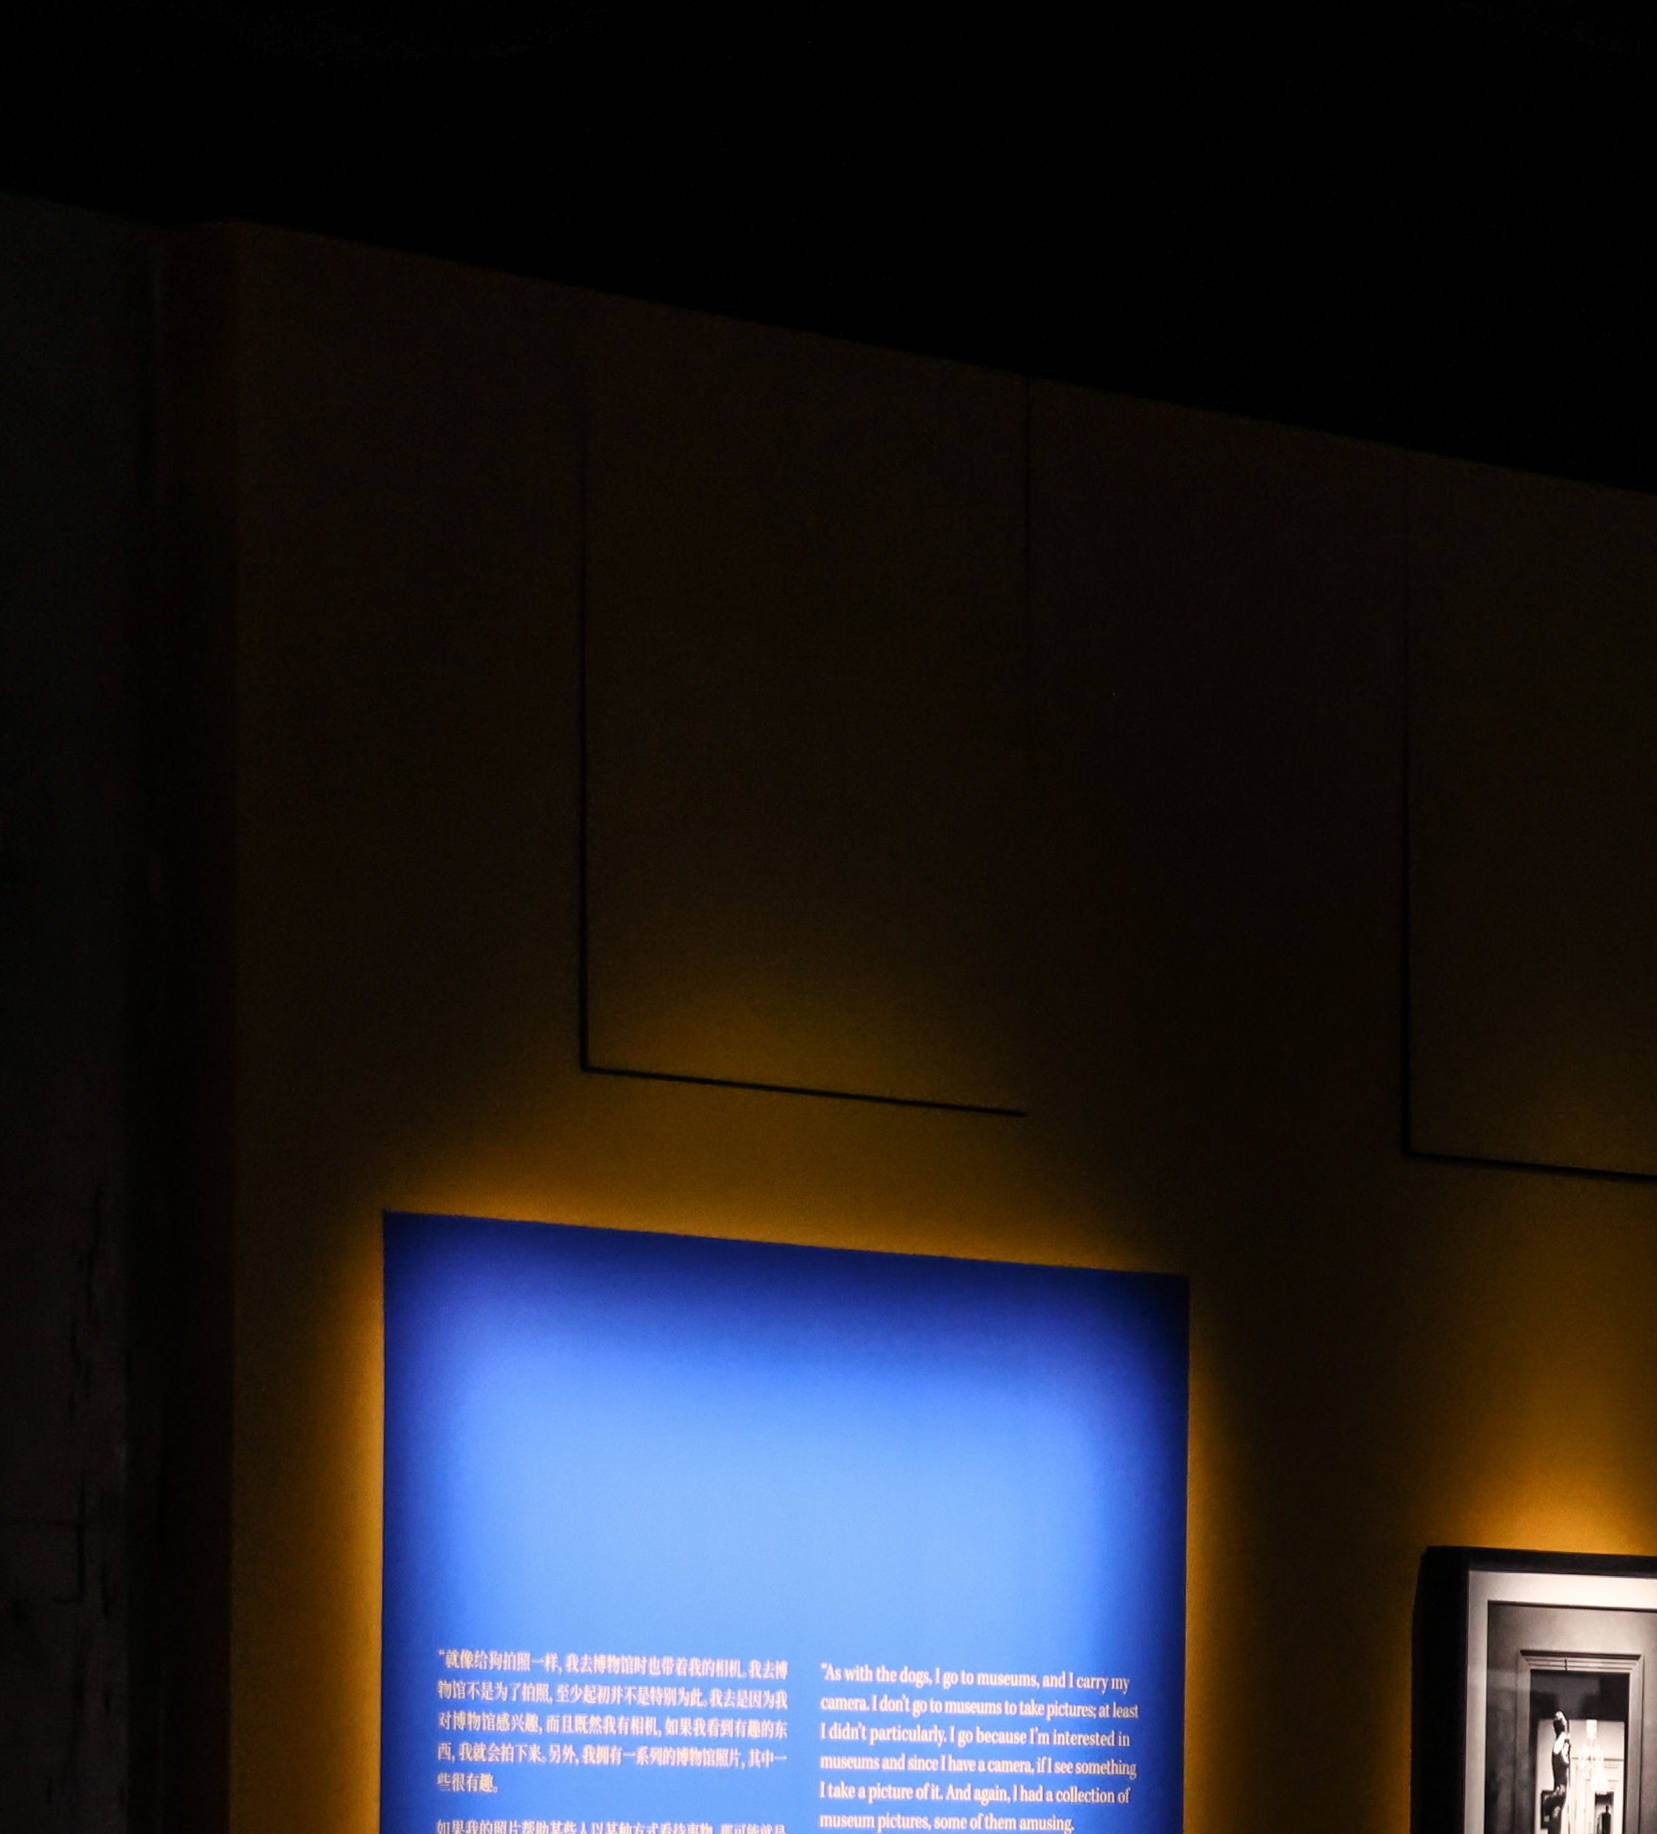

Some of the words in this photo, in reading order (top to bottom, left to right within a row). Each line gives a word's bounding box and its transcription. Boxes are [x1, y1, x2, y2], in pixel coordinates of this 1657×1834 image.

[844, 1664, 874, 1683] with
[875, 1665, 898, 1683] the
[898, 1666, 933, 1689] dogs,
[935, 1667, 941, 1684] I
[942, 1672, 959, 1690] go
[960, 1670, 975, 1686] to
[976, 1672, 1040, 1688] museums,
[1042, 1671, 1066, 1689] and
[1069, 1672, 1074, 1688] I
[1076, 1677, 1108, 1694] carry
[1111, 1678, 1130, 1695] my
[820, 1697, 870, 1712] camera.
[871, 1694, 877, 1712] I
[911, 1700, 928, 1718] go
[929, 1698, 943, 1714] to
[944, 1701, 1003, 1716] museums
[1004, 1701, 1018, 1716] to
[1018, 1699, 1045, 1717] take
[1046, 1701, 1097, 1722] pictures;
[1098, 1704, 1110, 1718] at
[1112, 1702, 1138, 1719] least
[820, 1722, 826, 1739] I
[869, 1724, 947, 1748] particularly.
[949, 1726, 955, 1743] I
[957, 1730, 974, 1748] go
[975, 1726, 1027, 1745] because
[1052, 1729, 1115, 1747] interested
[1118, 1732, 1130, 1747] in
[820, 1756, 881, 1770] museums
[881, 1753, 906, 1771] and
[907, 1755, 939, 1772] since
[940, 1755, 946, 1772] I
[947, 1754, 977, 1773] have
[977, 1760, 986, 1773] a
[988, 1759, 1034, 1775] camera,
[1036, 1756, 1047, 1774] if
[1047, 1757, 1053, 1774] I
[1054, 1762, 1073, 1775] see
[1075, 1759, 1136, 1780] something
[437, 1773, 498, 1793] 些很有趣。
[820, 1781, 825, 1798] I
[827, 1781, 856, 1799] take
[857, 1786, 866, 1800] a
[868, 1783, 914, 1805] picture
[915, 1782, 931, 1800] of
[930, 1784, 944, 1801] it.
[945, 1783, 972, 1801] And
[973, 1785, 1010, 1807] again,
[1013, 1783, 1018, 1803] I
[1019, 1784, 1043, 1802] had
[1045, 1790, 1054, 1802] a
[1055, 1786, 1115, 1803] collection
[1117, 1788, 1130, 1804] of
[819, 1815, 875, 1829] museum
[877, 1813, 932, 1834] pictures,
[934, 1817, 968, 1830] some
[969, 1813, 984, 1830] of
[984, 1813, 1017, 1831] them
